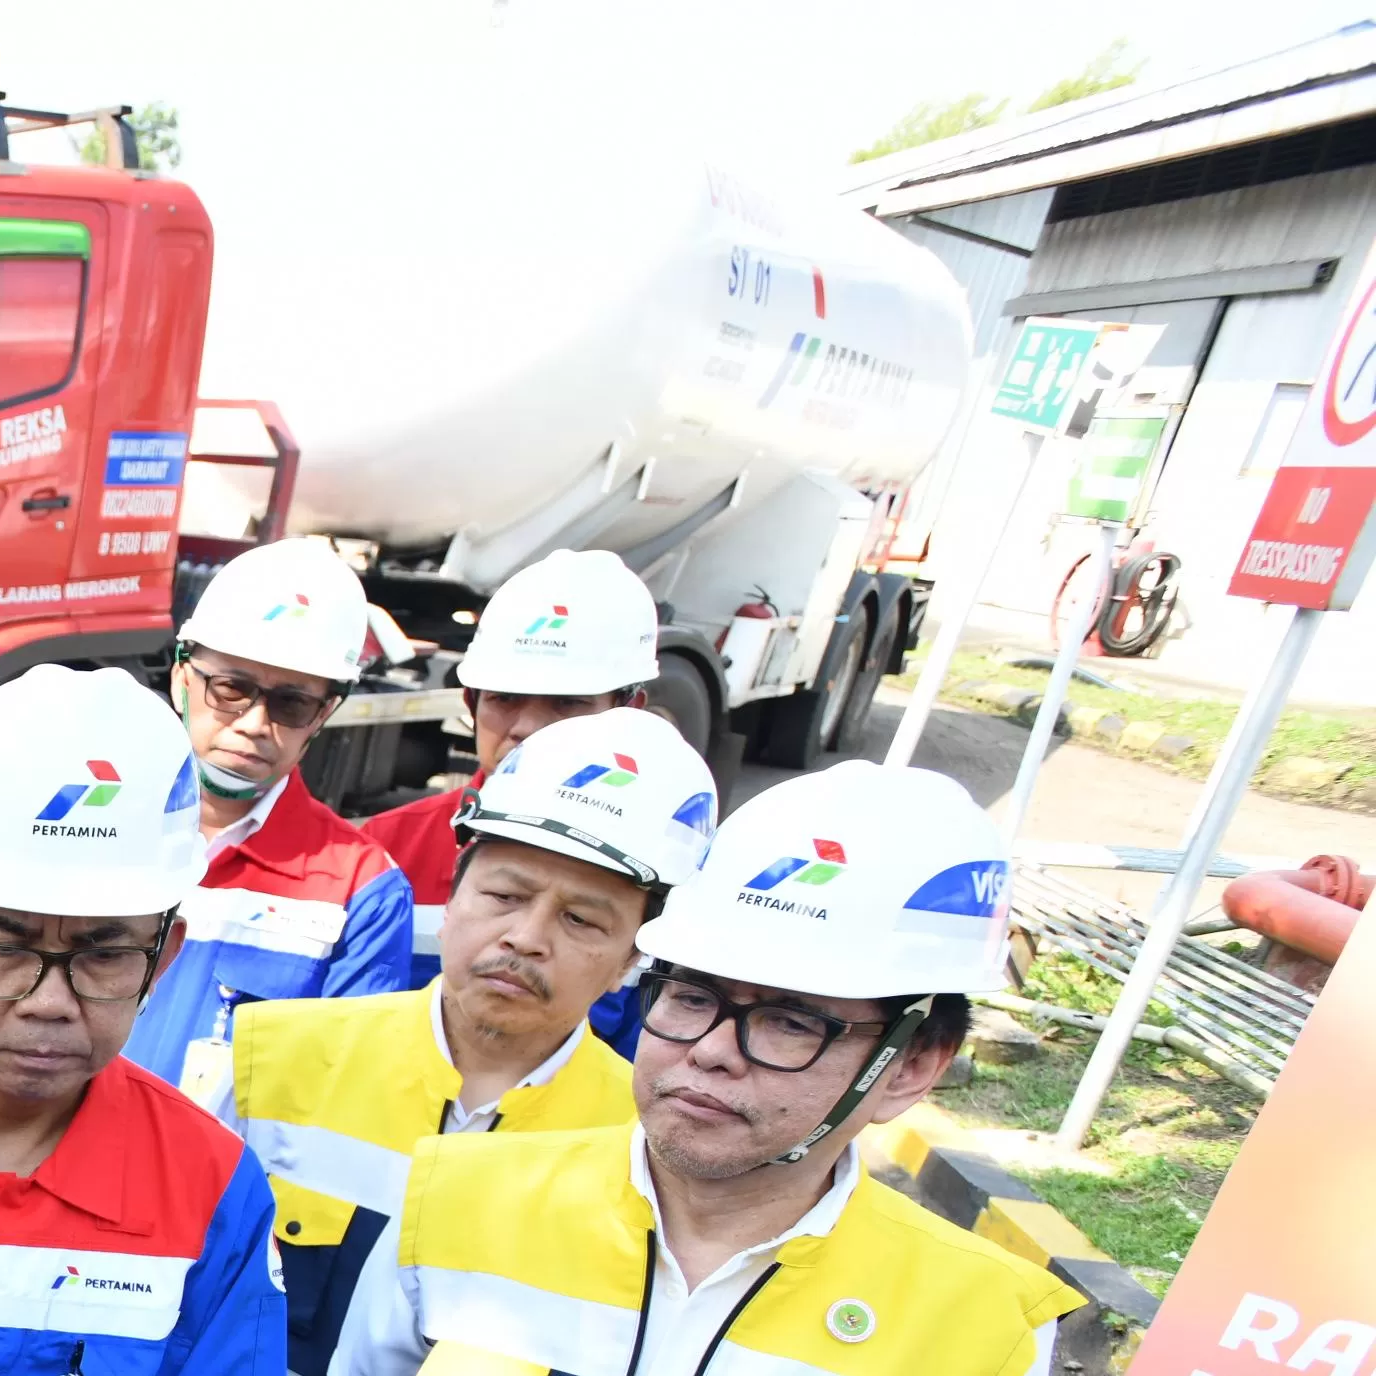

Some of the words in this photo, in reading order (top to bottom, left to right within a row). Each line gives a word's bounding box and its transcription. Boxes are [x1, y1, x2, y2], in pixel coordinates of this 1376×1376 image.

[0, 406, 67, 449] REKSA
[1296, 488, 1332, 524] NO
[65, 577, 140, 600] MEROKOK
[515, 638, 567, 650] PERTAMINA
[556, 789, 623, 817] PERTAMINA
[33, 824, 117, 838] PERTAMINA
[737, 892, 827, 920] PERTAMINA
[84, 1278, 152, 1294] PERTAMINA
